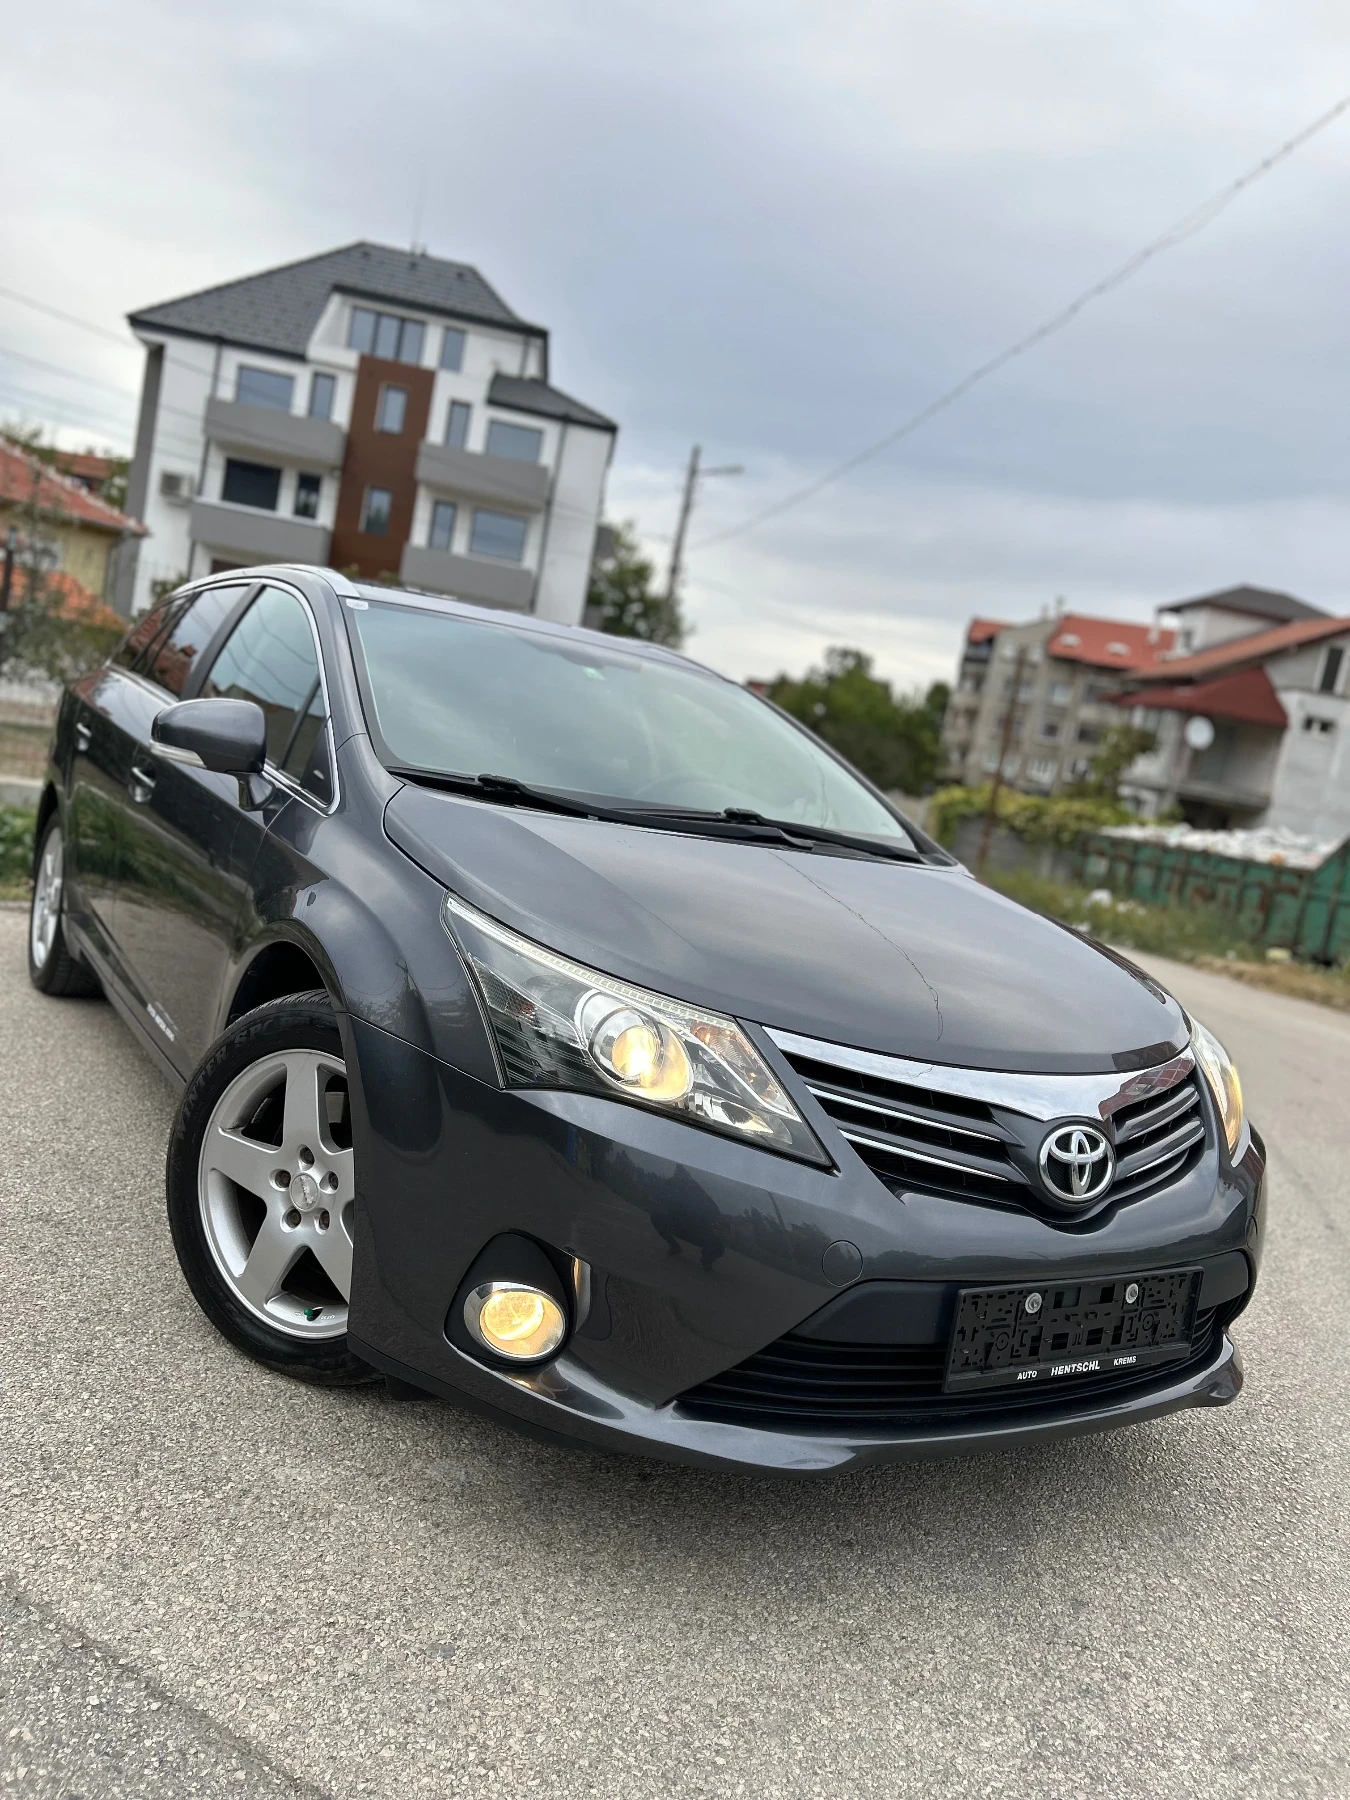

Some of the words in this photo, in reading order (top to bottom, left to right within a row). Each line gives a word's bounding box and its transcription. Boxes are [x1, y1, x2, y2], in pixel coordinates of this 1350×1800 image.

[177, 1044, 228, 1141] WINTER
[1017, 1370, 1037, 1380] AUTO
[1050, 1360, 1100, 1376] HENTSCHL
[1113, 1355, 1136, 1365] KREMS
